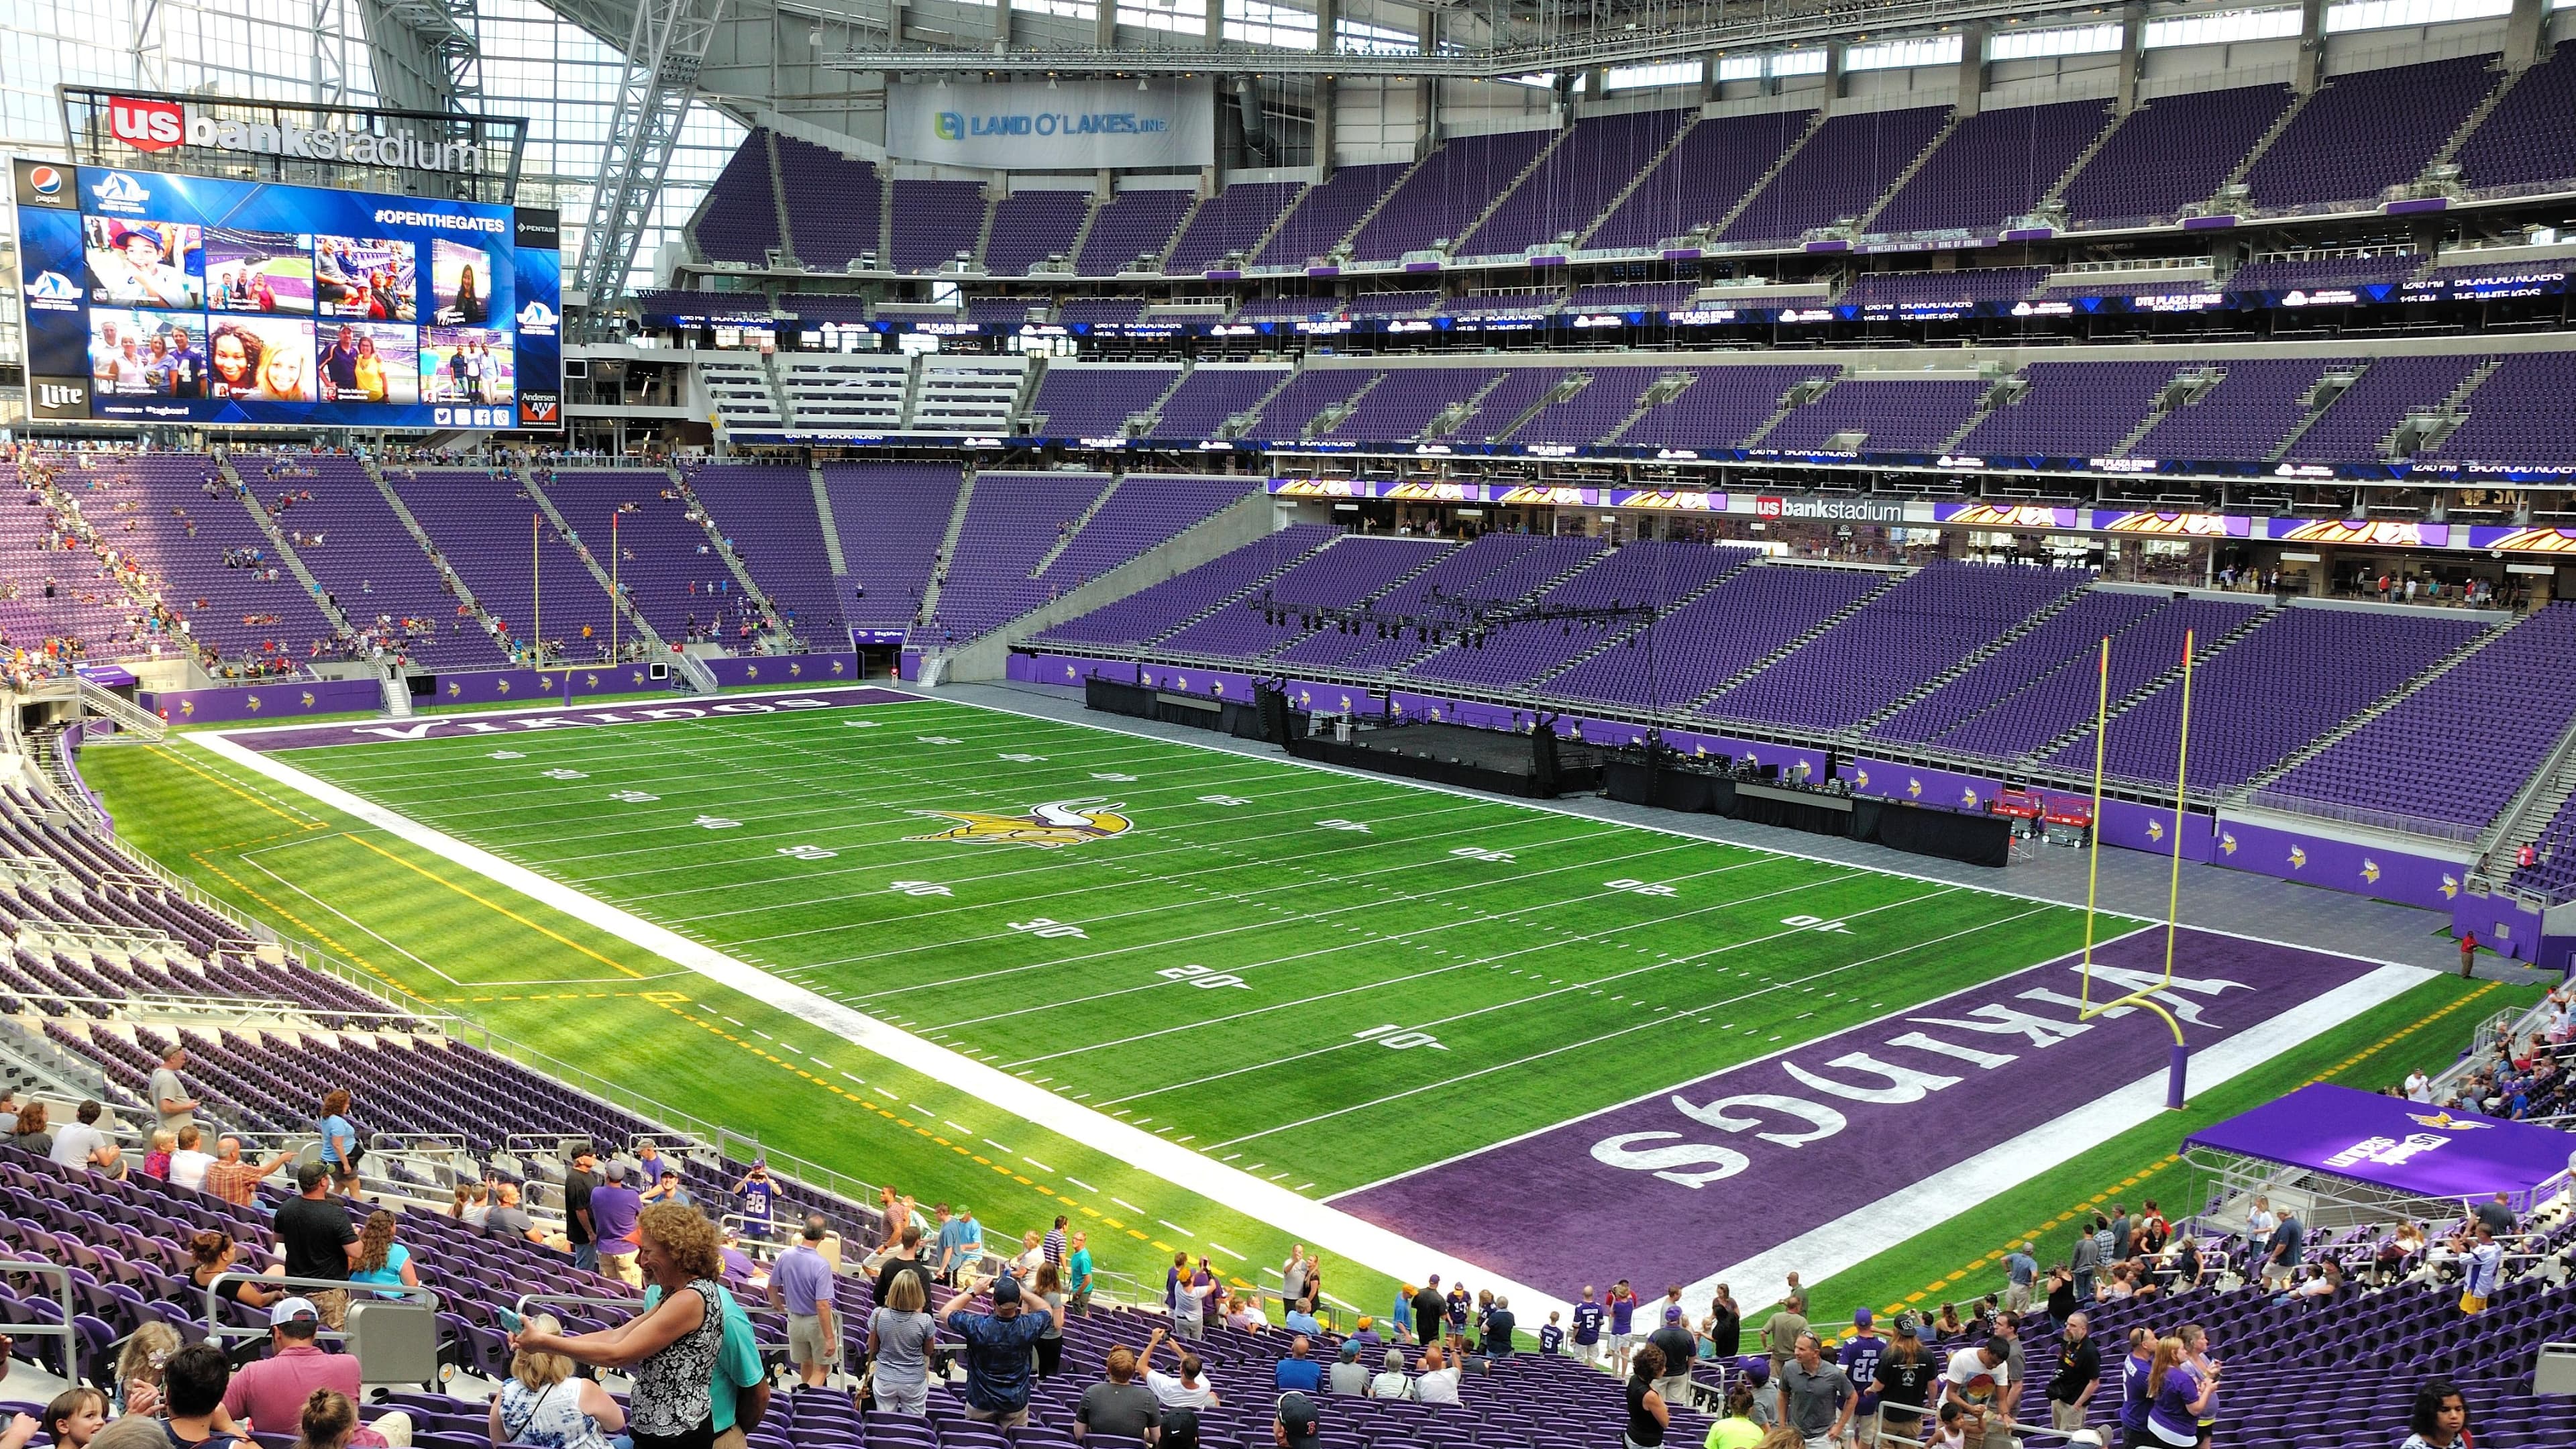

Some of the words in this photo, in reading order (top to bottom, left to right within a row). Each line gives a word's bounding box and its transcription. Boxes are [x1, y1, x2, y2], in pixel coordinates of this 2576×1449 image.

[971, 115, 1030, 135] LAND
[36, 195, 60, 204] pepsi
[374, 209, 504, 233] #OPENTHEGATES
[526, 225, 556, 233] PENTAIR
[2155, 295, 2188, 305] PLAZA
[179, 359, 192, 382] 4
[38, 384, 83, 409] Lite
[521, 392, 556, 401] Andersen
[352, 699, 833, 739] VIKINGS
[776, 845, 838, 859] 50
[1449, 847, 1515, 860] 30
[890, 881, 951, 896] 40
[1603, 878, 1677, 894] 20
[1006, 918, 1083, 938] 30
[1780, 915, 1846, 932] 10
[1155, 964, 1244, 987] 20
[1352, 1024, 1438, 1049] 10
[1590, 963, 2257, 1187] VIKINGS
[746, 1193, 765, 1214] 28
[1586, 1315, 1595, 1329] 5
[1544, 1336, 1553, 1348] 5
